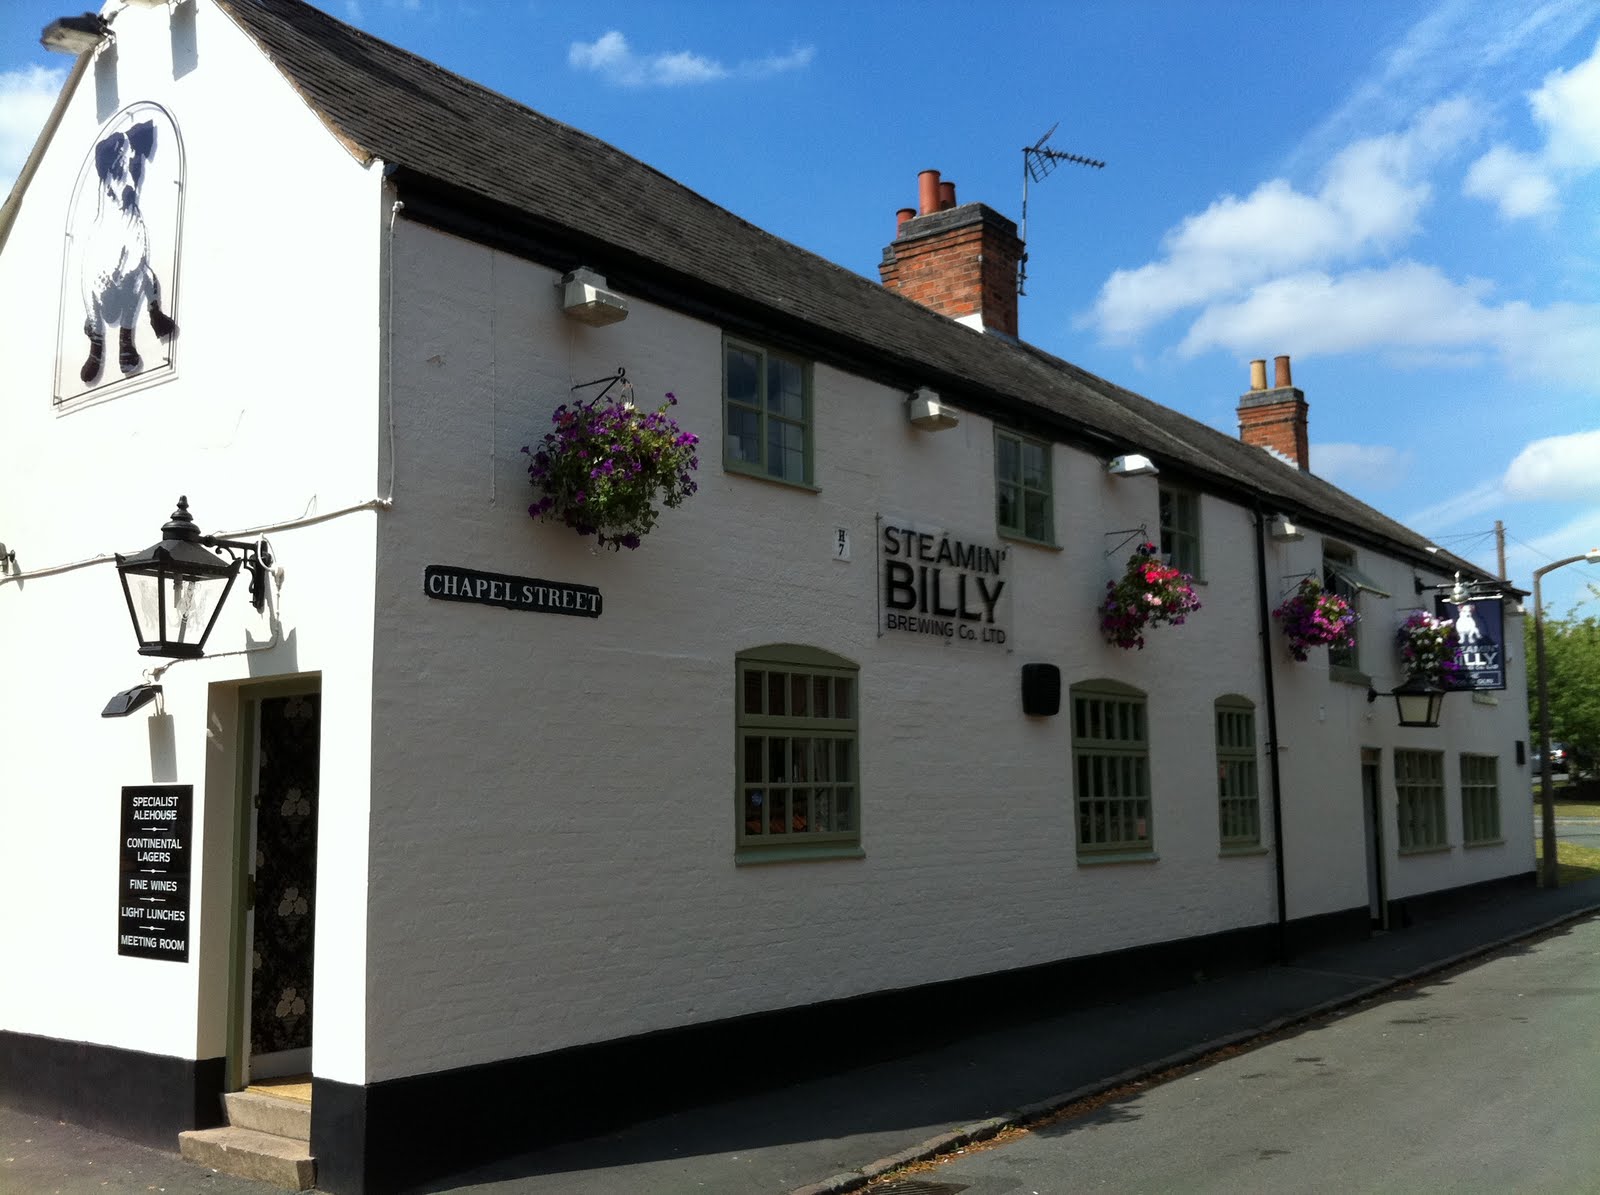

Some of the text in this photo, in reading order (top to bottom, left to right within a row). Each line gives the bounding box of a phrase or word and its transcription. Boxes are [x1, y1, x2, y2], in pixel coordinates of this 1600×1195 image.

[838, 528, 846, 543] H
[839, 543, 845, 556] 7
[884, 525, 1006, 576] STEAMIN'
[429, 574, 602, 612] CHAPEL STREET
[886, 559, 1006, 624] BILLY
[887, 613, 1007, 644] BREWING Co. LTD
[132, 796, 179, 807] SPECIALIST
[133, 810, 177, 821] ALEHOUSE
[126, 838, 182, 849] CONTINENTAL
[137, 852, 171, 863] LAGERS
[129, 879, 177, 892] FINE WINES
[121, 907, 186, 922] LIGHT LUNCHES
[120, 935, 185, 951] MEETING ROOM
